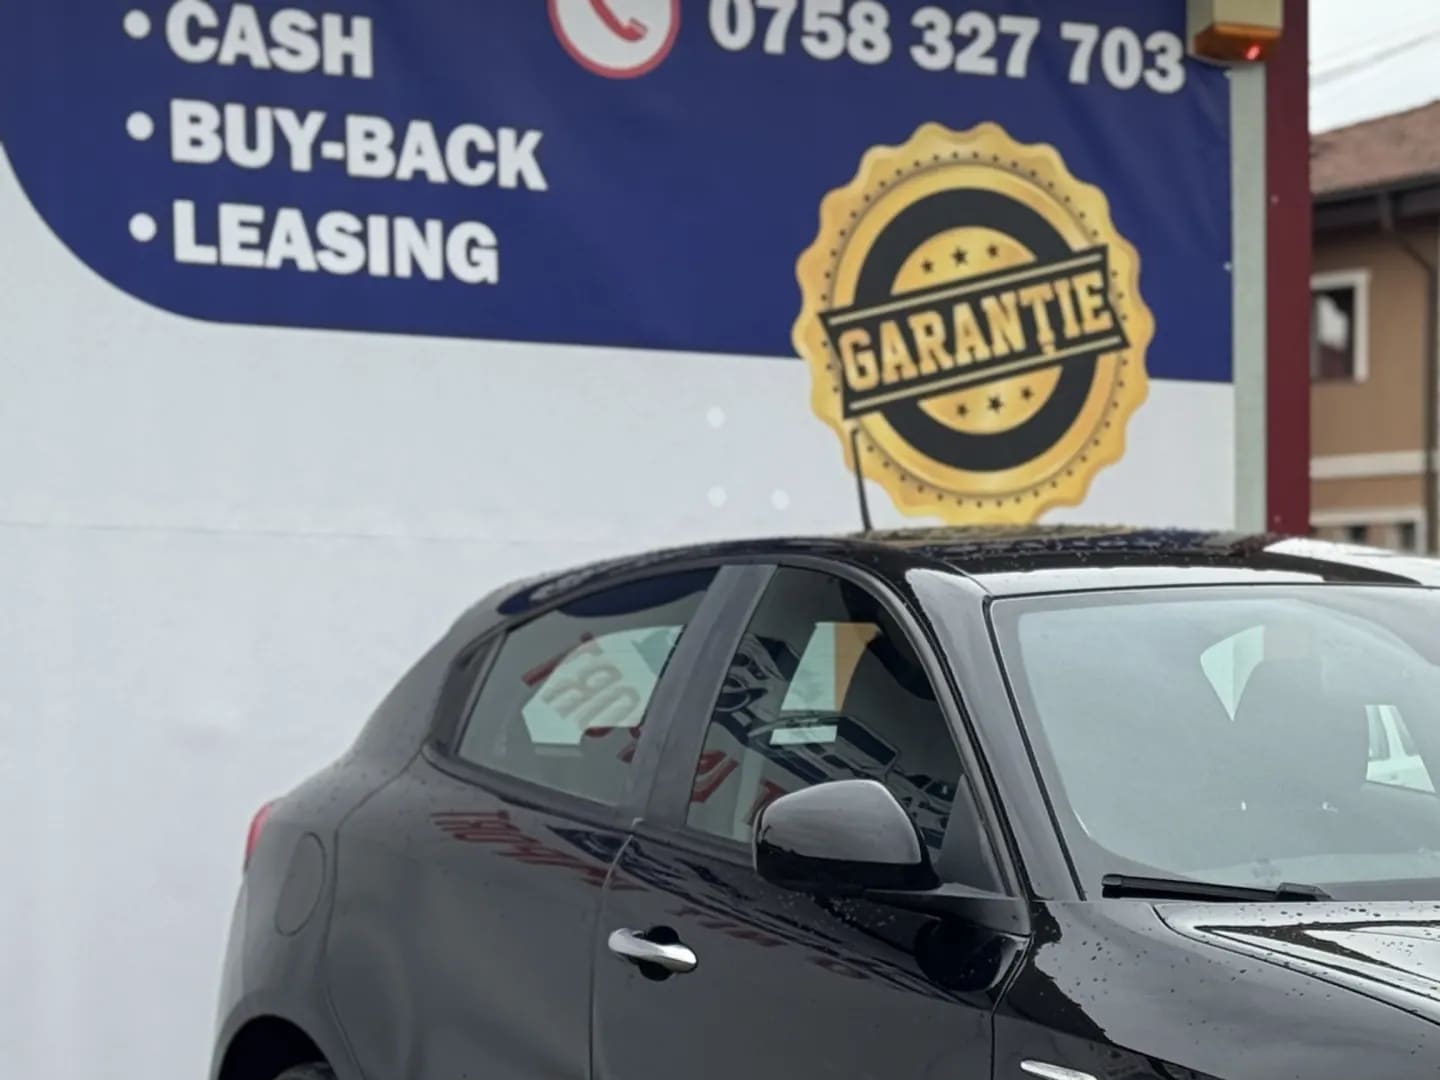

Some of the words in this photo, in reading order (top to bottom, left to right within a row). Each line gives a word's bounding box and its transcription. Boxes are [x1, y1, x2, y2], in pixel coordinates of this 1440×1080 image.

[165, 0, 374, 79] CASH
[707, 0, 892, 65] 0758
[910, 6, 1039, 79] 327
[1060, 22, 1186, 94] 703
[170, 98, 549, 191] BUY-BACK
[173, 199, 499, 284] LEASING
